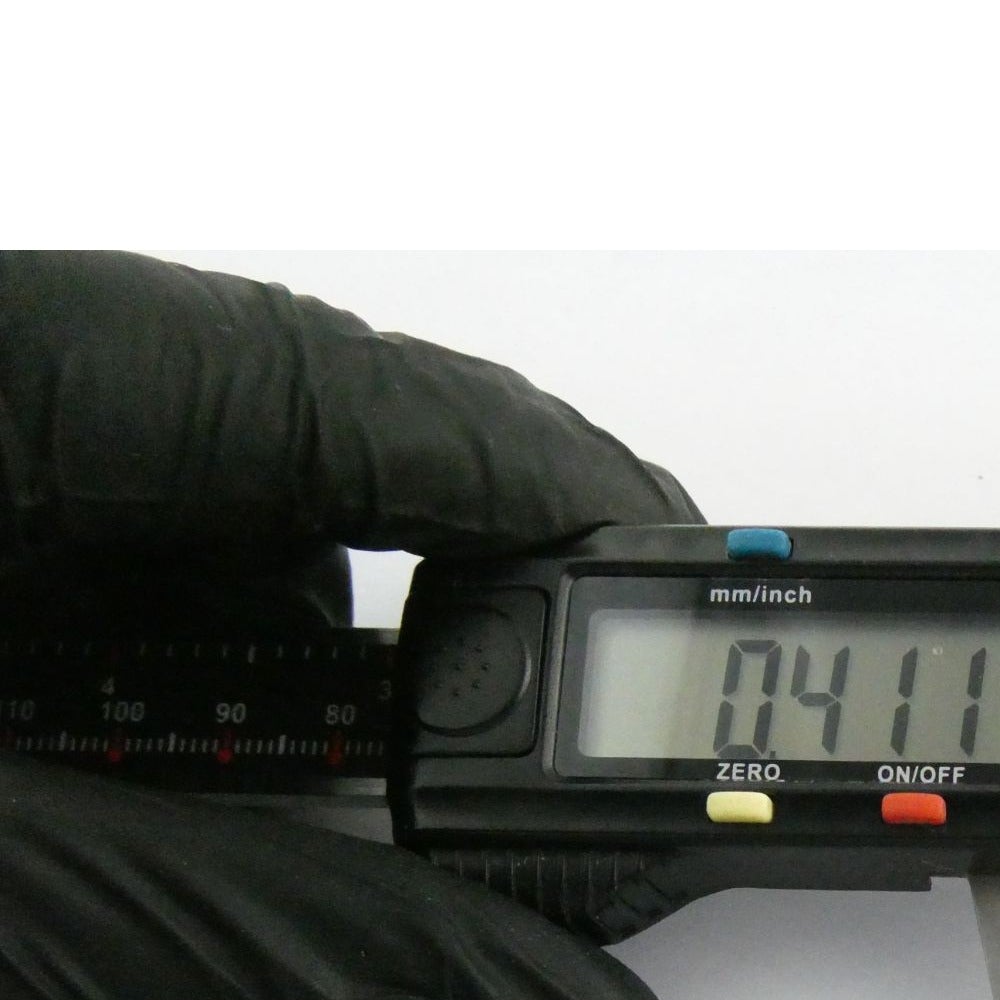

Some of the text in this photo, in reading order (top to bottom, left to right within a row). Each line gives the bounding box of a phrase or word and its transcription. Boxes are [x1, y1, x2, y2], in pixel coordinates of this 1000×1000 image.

[710, 584, 812, 604] mm/inch
[101, 677, 115, 695] 4
[379, 680, 392, 700] 3
[713, 639, 987, 758] 0.411
[103, 701, 145, 722] 100
[215, 702, 247, 724] 90
[325, 704, 356, 726] 80
[716, 762, 781, 782] ZERO
[877, 763, 966, 785] ON/OFF
